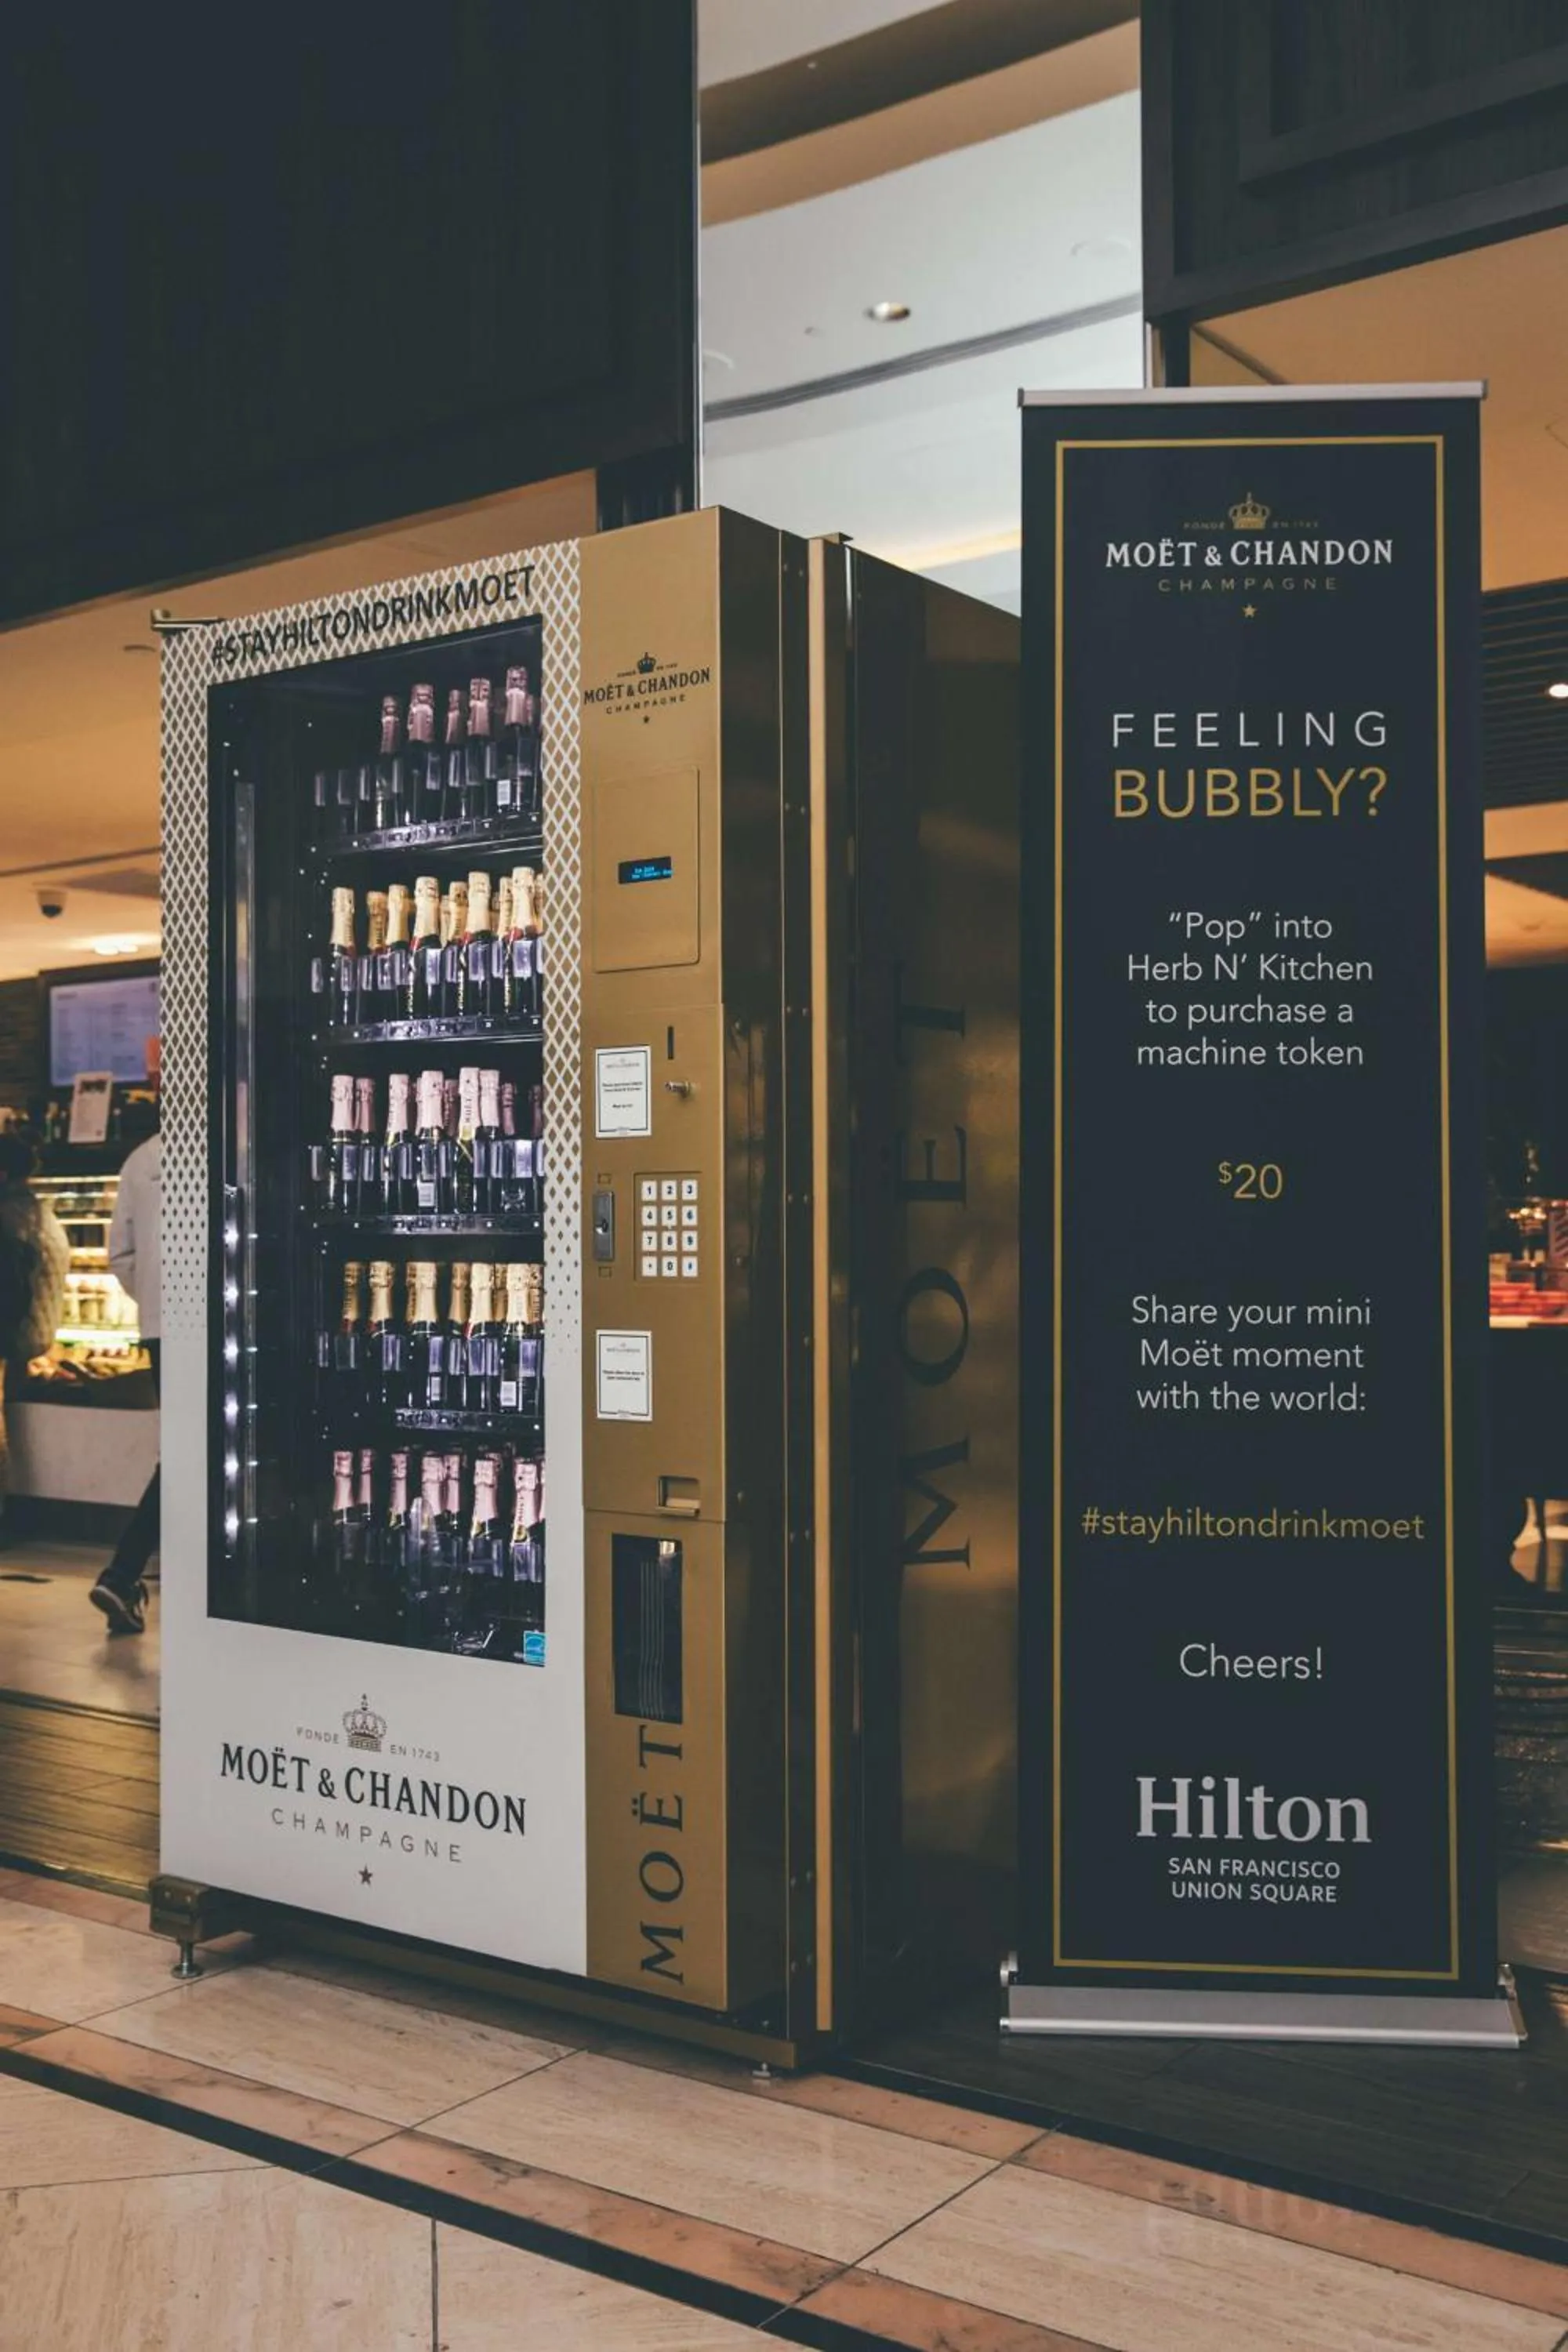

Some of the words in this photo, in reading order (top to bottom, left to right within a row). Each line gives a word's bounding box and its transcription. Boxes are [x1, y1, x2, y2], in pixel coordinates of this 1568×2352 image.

[1105, 538, 1197, 568] MOËT
[1204, 545, 1222, 567] &
[1230, 539, 1392, 565] CHANDON
[1158, 577, 1334, 592] CHAMPAGNE
[212, 564, 536, 666] #STAYHILTONDRINKMOET
[637, 666, 711, 695] CHANDON
[606, 694, 687, 714] CHAMPAGNE
[1112, 710, 1385, 748] FEELING
[1115, 767, 1387, 818] BUBBLY?
[1275, 912, 1333, 938] into
[1128, 953, 1203, 981] Herb
[1260, 953, 1373, 981] Kitchen
[1145, 1000, 1178, 1023] to
[1188, 993, 1327, 1031] purchase
[1338, 1004, 1353, 1023] a
[1138, 1036, 1267, 1065] machine
[1276, 1036, 1363, 1065] token
[1218, 1161, 1283, 1199] $20
[1132, 1294, 1218, 1324] Share
[1228, 1305, 1297, 1332] your
[1307, 1298, 1370, 1325] mini
[1141, 1338, 1223, 1367] Moët
[1233, 1344, 1364, 1368] moment
[1136, 1380, 1199, 1410] with
[1210, 1381, 1260, 1410] the
[1269, 1381, 1366, 1411] world:
[1081, 1506, 1424, 1544] #stayhiltondrinkmoet
[1180, 1642, 1322, 1679] Cheers!
[390, 1744, 407, 1756] EN
[220, 1743, 310, 1793] MOËT
[318, 1768, 337, 1799] &
[343, 1765, 527, 1836] CHANDON
[1136, 1776, 1371, 1843] Hilton
[270, 1807, 463, 1864] CHAMPAGNE
[631, 1724, 684, 1986] MOËT
[1168, 1857, 1211, 1875] SAN
[1219, 1858, 1341, 1879] FRANCISCO
[1172, 1881, 1242, 1900] UNION
[1250, 1883, 1337, 1904] SQUARE
